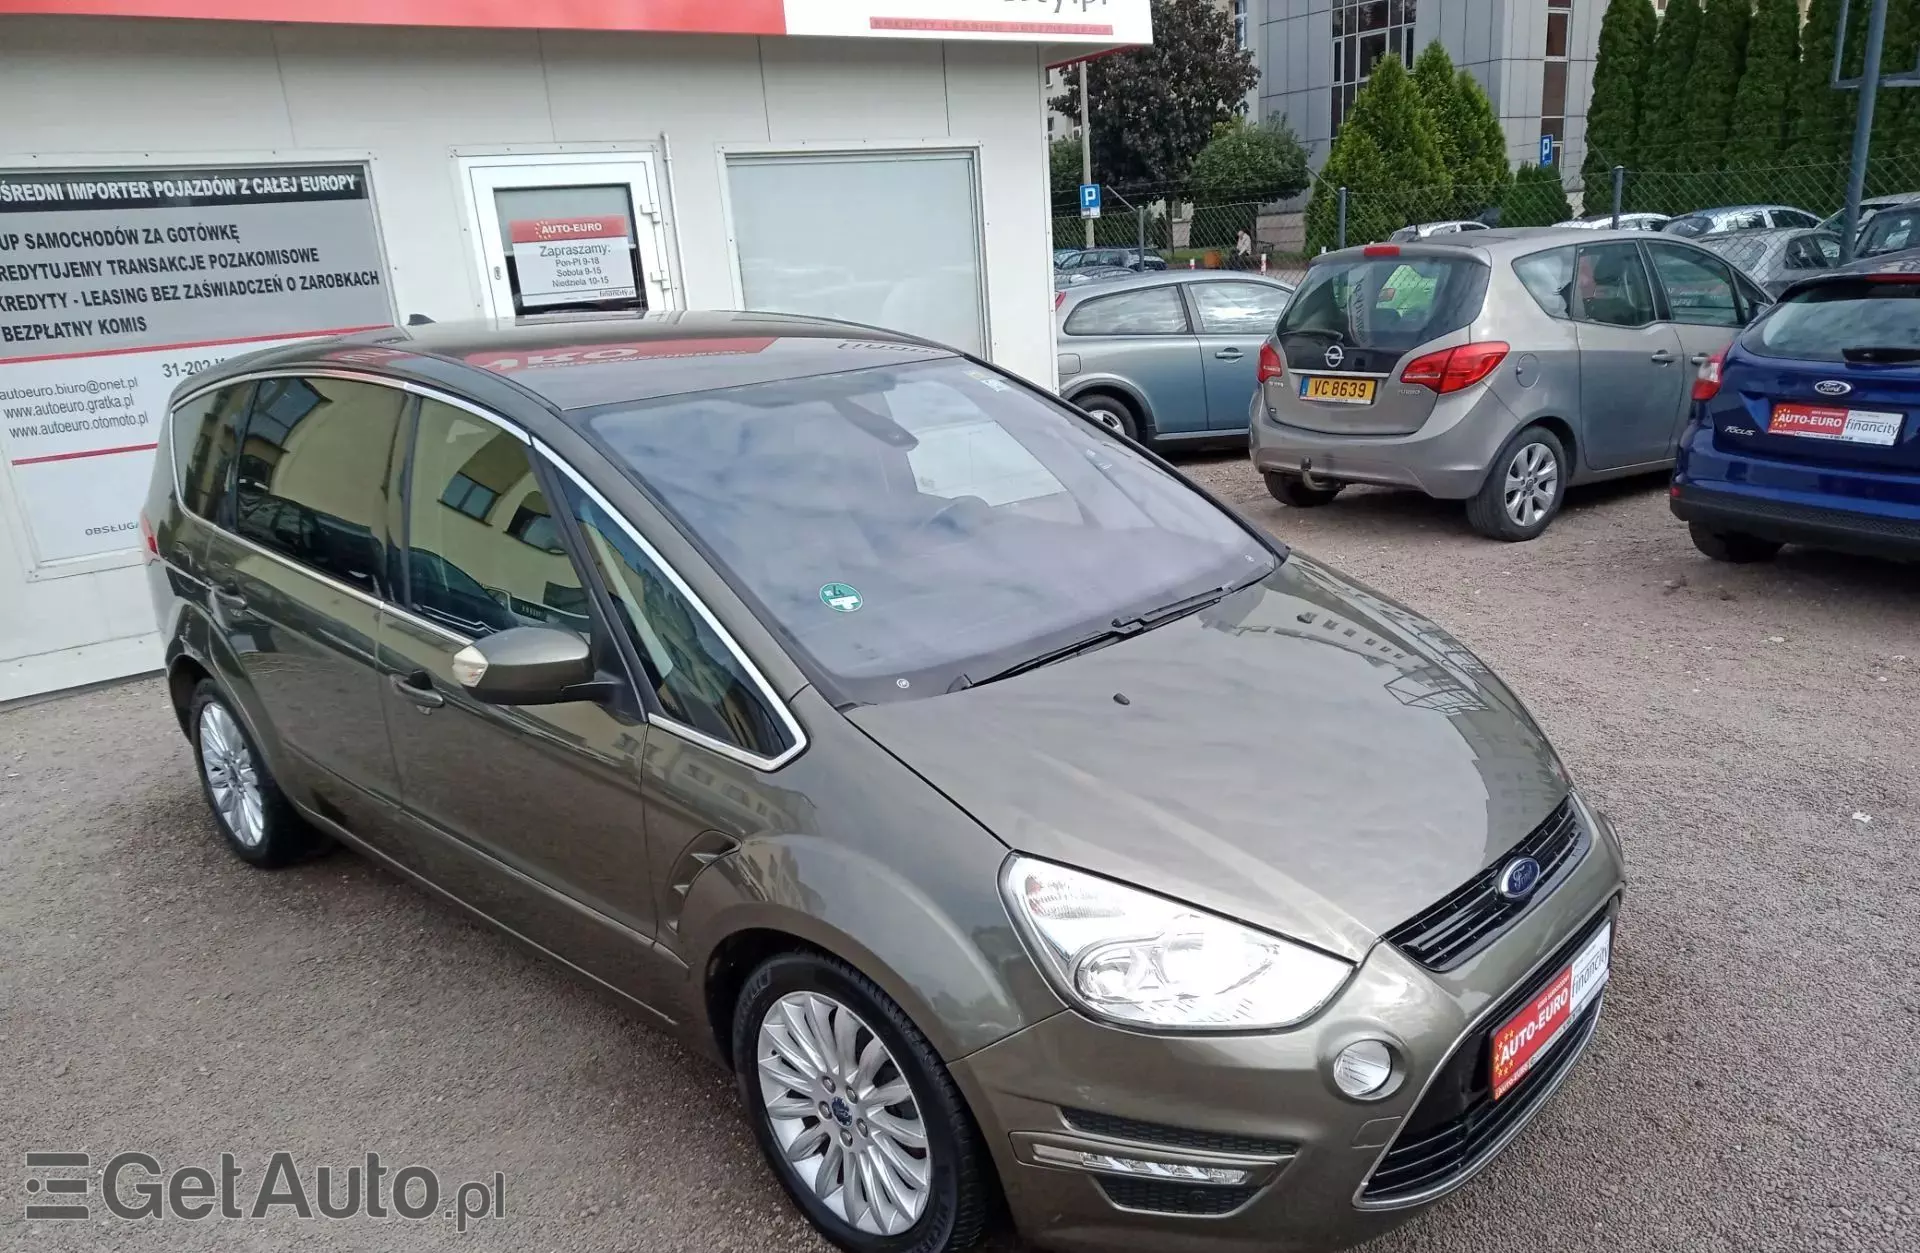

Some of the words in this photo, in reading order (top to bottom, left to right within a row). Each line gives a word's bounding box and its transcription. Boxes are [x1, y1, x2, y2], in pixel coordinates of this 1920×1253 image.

[1542, 138, 1550, 160] P
[0, 180, 64, 202] ŚREDNI
[66, 182, 151, 200] IMPORTER
[154, 175, 237, 198] POJAZDÓW
[241, 179, 251, 194] Z
[253, 175, 297, 194] CAŁEJ
[300, 174, 356, 192] EUROPY
[1084, 188, 1096, 205] P
[25, 225, 139, 250] SAMOCHODÓW
[143, 228, 164, 245] ZA
[167, 221, 241, 244] GOTÓWKĘ
[541, 222, 602, 234] AUTO-EURO
[107, 254, 206, 276] TRANSAKCJE
[208, 247, 320, 270] POZAKOMISOWE
[540, 244, 611, 258] Zapraszamy:
[583, 257, 600, 266] 9-18
[552, 278, 587, 288] Niedziela
[589, 276, 609, 285] 10-15
[556, 268, 583, 277] Sobota
[585, 266, 602, 275] 9-15
[81, 286, 147, 308] LEASING
[151, 283, 181, 302] BEZ
[183, 274, 284, 300] ZAŚWIADCZEŃ
[286, 275, 296, 291] O
[300, 270, 380, 291] ZAROBKACH
[1, 320, 93, 342] BEZPŁATNY
[99, 315, 147, 335] KOMIS
[0, 376, 139, 400] autoeuro.biuro@onet.pl
[1314, 380, 1330, 396] VC
[1331, 380, 1367, 398] 8639
[4, 394, 135, 419] www.autoeuro.gratka.pl
[9, 411, 149, 439] www.autoeuro.otomoto.pl
[1779, 413, 1842, 427] AUTO-EURO
[1846, 419, 1899, 436] financity
[1501, 987, 1569, 1066] AUTO-EURO
